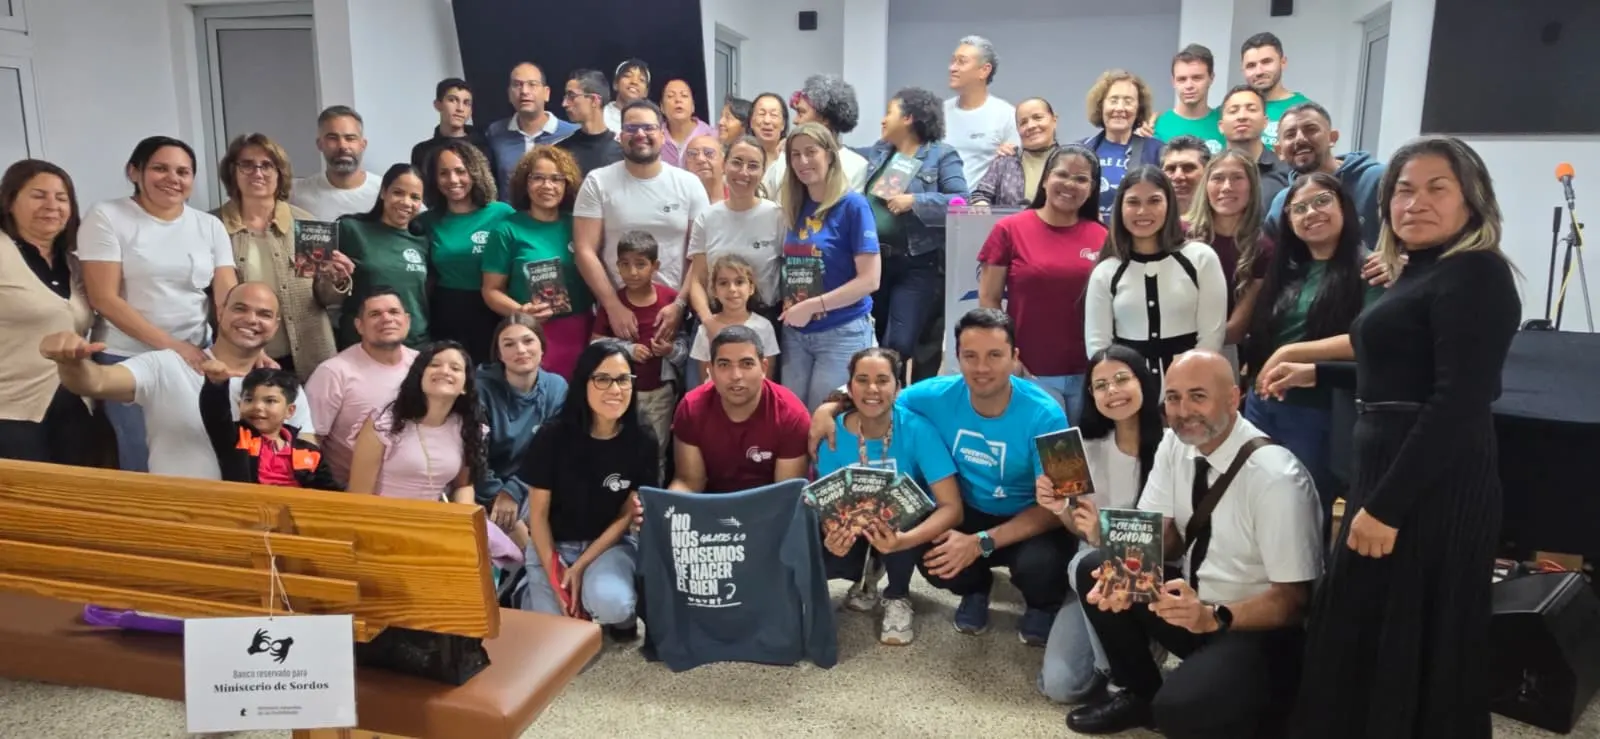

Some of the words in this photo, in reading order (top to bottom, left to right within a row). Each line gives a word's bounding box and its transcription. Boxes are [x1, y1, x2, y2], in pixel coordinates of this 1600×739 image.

[671, 513, 691, 531] NO
[671, 530, 700, 549] NOS
[1109, 531, 1153, 544] BONDAD
[673, 545, 745, 564] CANSEMOS
[675, 563, 689, 580] DE
[690, 562, 733, 580] HACER
[677, 577, 689, 593] EL
[689, 579, 719, 596] BIEN
[233, 670, 255, 679] Banco
[256, 668, 291, 678] reservado
[292, 669, 308, 679] para
[213, 682, 272, 693] Ministerio
[273, 681, 287, 691] de
[289, 680, 329, 690] Sordos
